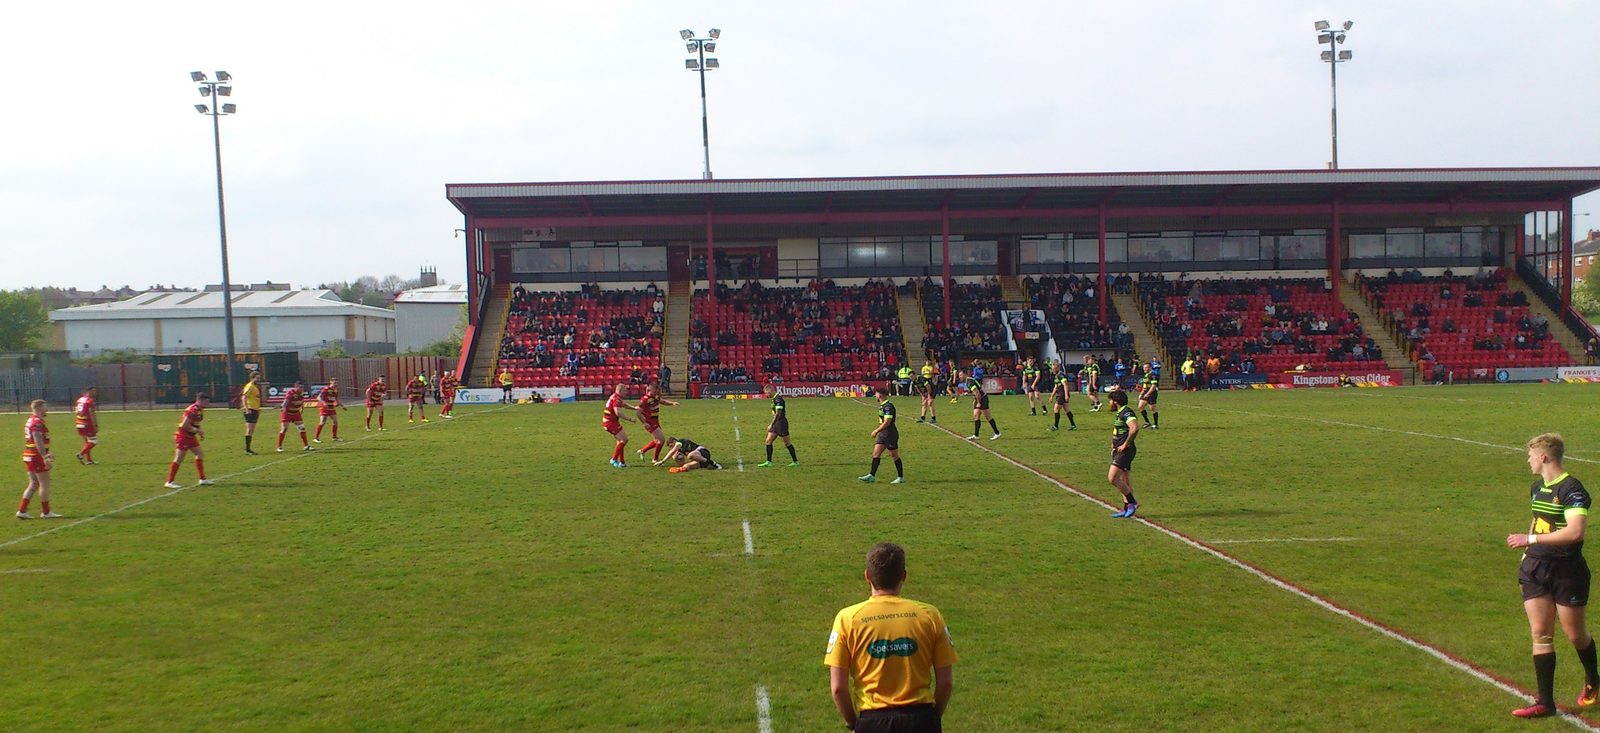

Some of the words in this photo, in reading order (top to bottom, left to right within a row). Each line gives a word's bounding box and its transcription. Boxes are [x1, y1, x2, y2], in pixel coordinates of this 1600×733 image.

[1293, 375, 1339, 387] Kingstone
[1366, 373, 1391, 385] Cider
[776, 385, 821, 397] Kingstone
[823, 384, 849, 394] Press
[871, 642, 914, 654] Specsavers
